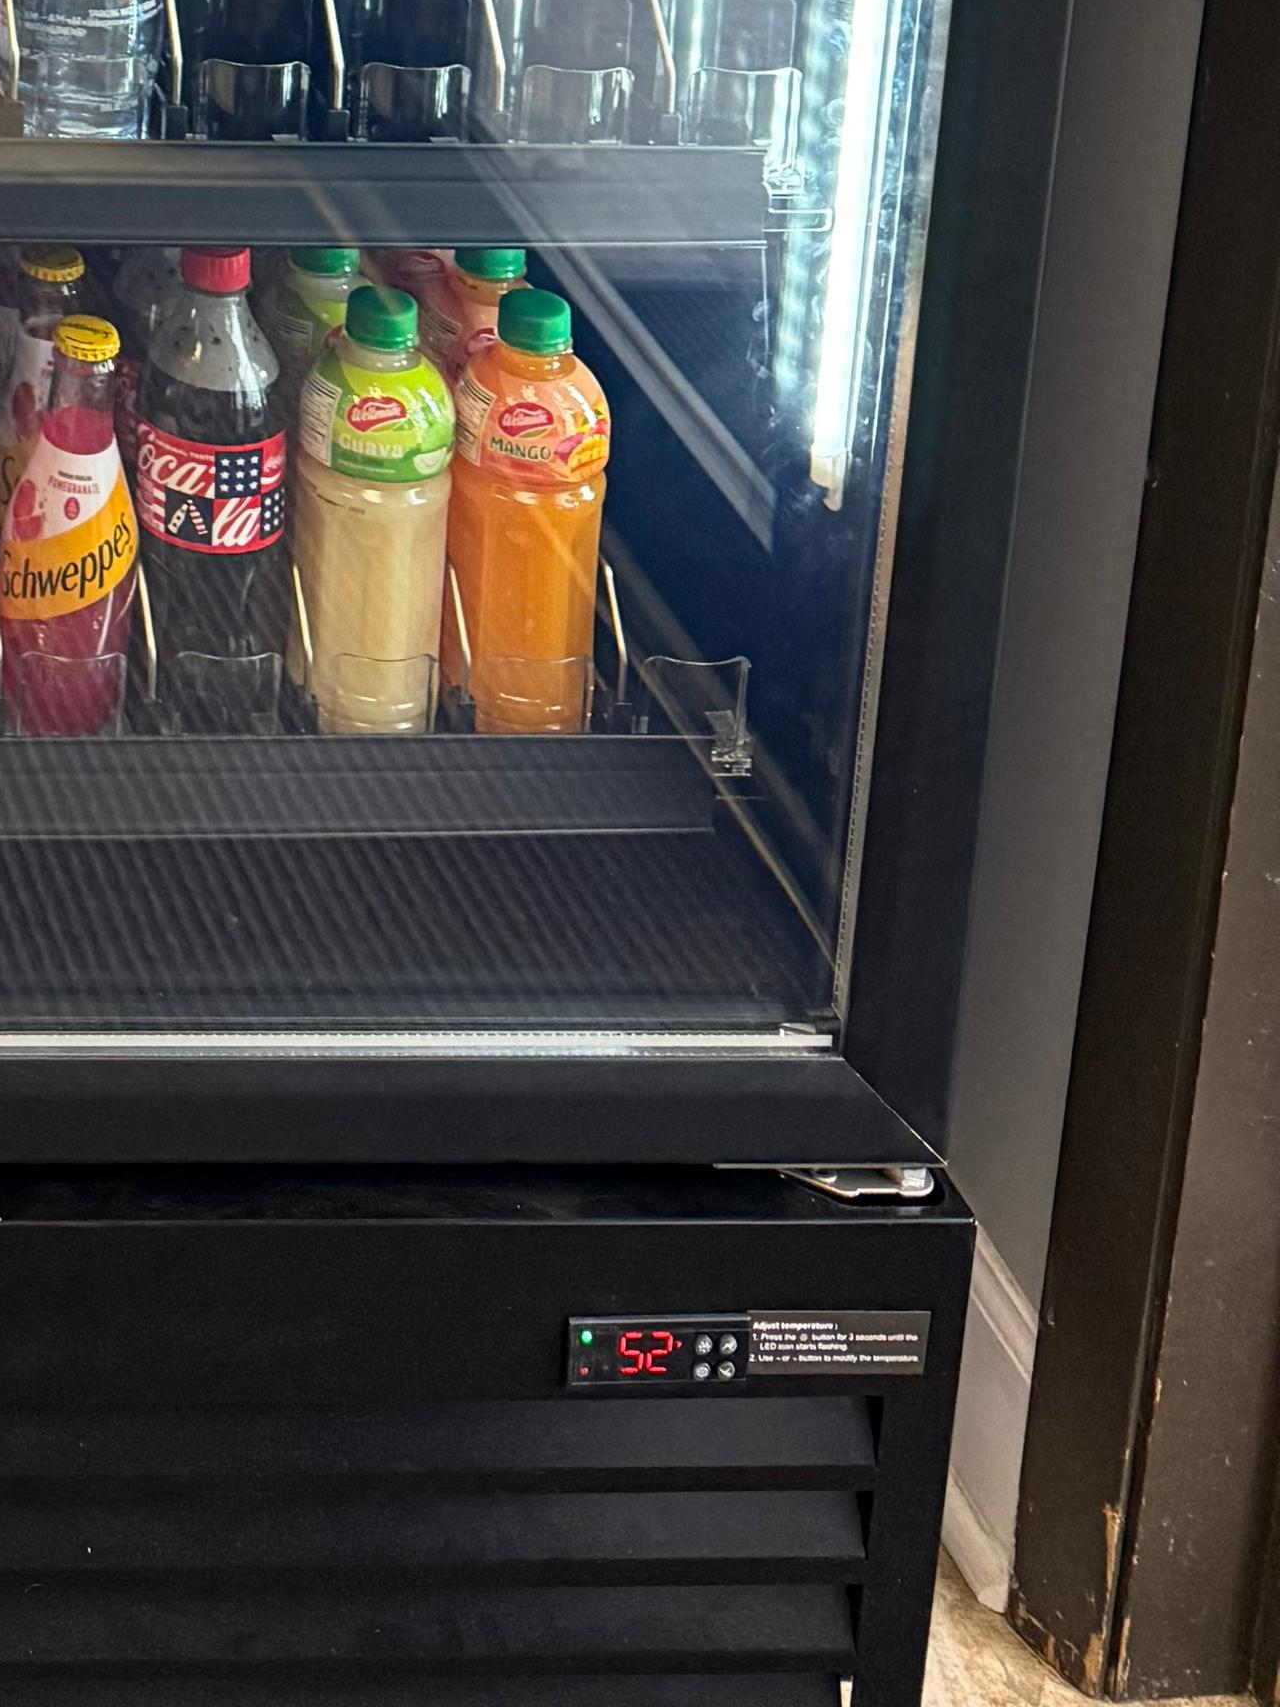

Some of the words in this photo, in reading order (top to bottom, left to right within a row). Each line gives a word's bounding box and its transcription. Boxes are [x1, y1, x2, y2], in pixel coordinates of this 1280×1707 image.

[490, 436, 553, 460] MANGO
[2, 511, 133, 599] Schweppes
[753, 1322, 780, 1331] Adjust
[619, 1331, 674, 1375] 52
